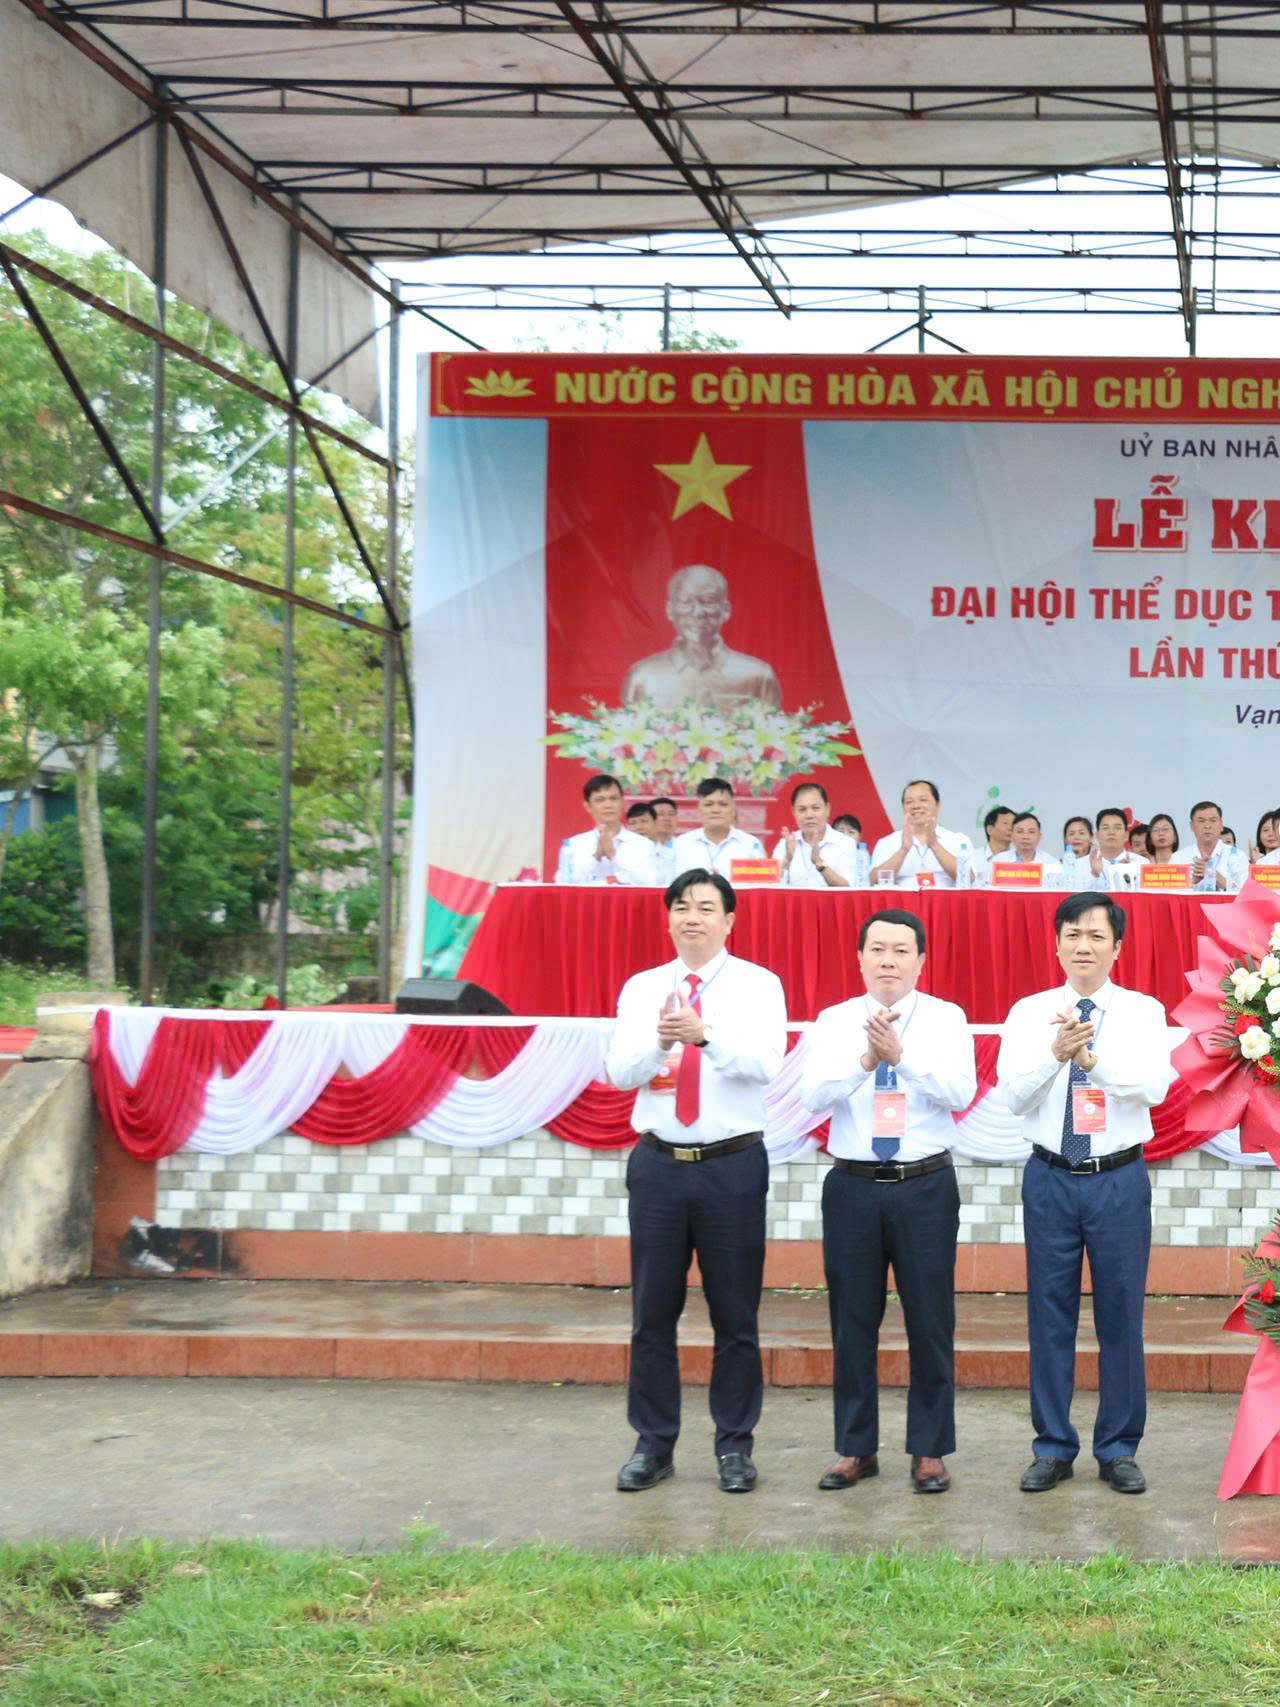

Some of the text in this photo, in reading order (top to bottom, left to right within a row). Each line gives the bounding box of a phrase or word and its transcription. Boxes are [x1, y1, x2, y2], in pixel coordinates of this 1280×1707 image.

[556, 368, 675, 404] NƯỚC
[692, 367, 811, 411] CỘNG
[828, 367, 915, 405] HÒA
[931, 369, 989, 406] XÃ
[1005, 370, 1077, 412] HỘI
[1094, 367, 1182, 409] CHỦ
[1120, 430, 1154, 458] UỶ
[1163, 439, 1216, 458] BAN
[1093, 475, 1185, 550] LỄ
[930, 587, 996, 625] ĐẠI
[1011, 581, 1075, 627] HỘI
[1089, 575, 1163, 620] THỂ
[1175, 589, 1252, 628] DỤC
[1130, 636, 1204, 678] LẦN
